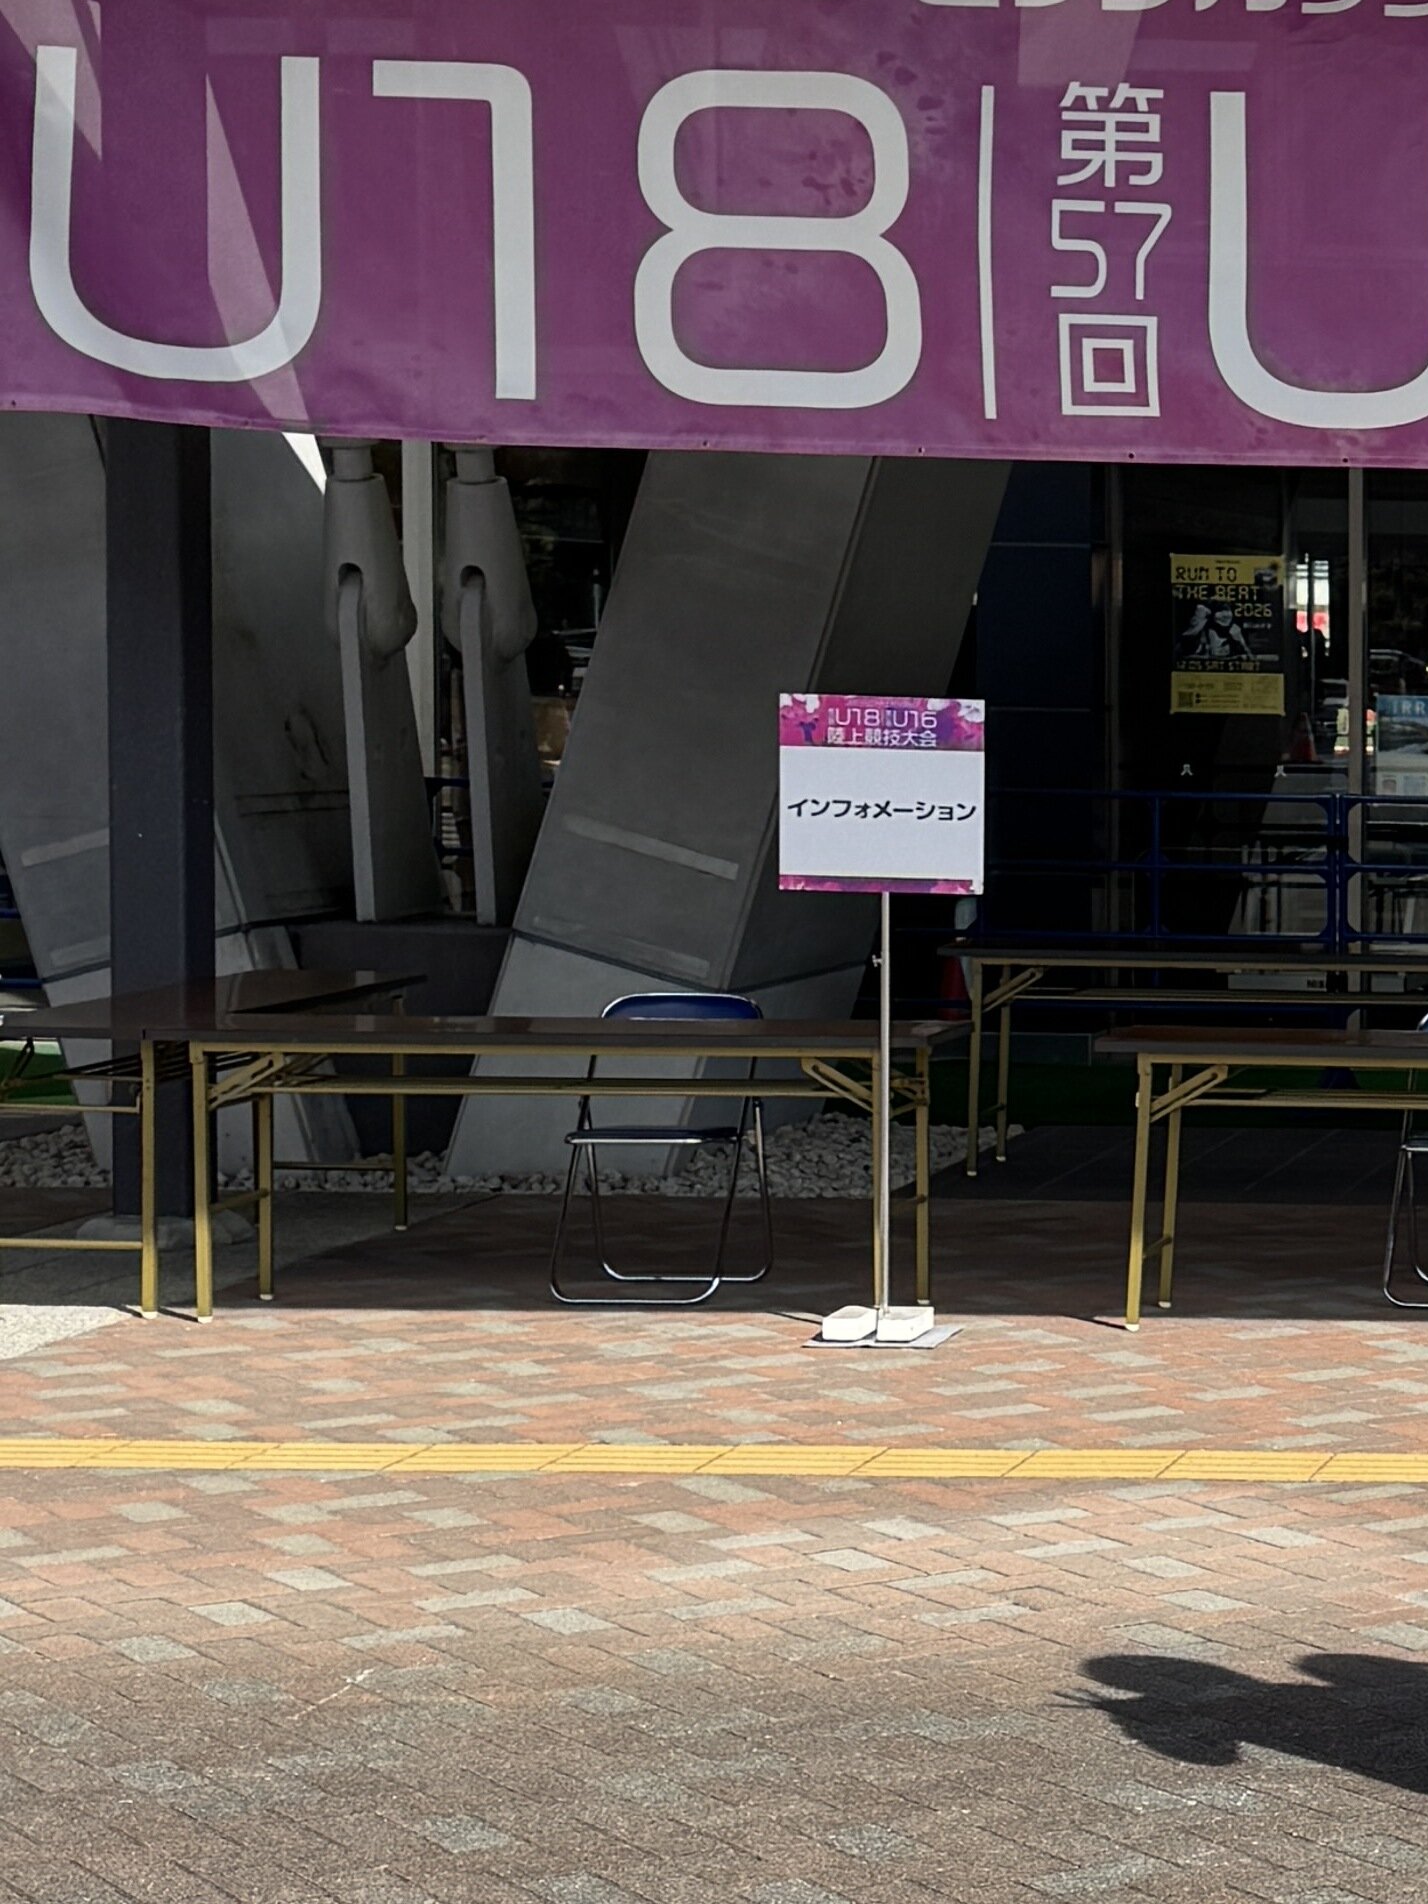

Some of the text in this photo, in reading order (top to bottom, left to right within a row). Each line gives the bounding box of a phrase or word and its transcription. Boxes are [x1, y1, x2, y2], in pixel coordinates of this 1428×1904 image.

[29, 45, 923, 409] U18
[1175, 566, 1237, 582] RUN TO
[1234, 602, 1273, 618] 2026
[828, 727, 937, 747] 陸上競技大会
[788, 798, 976, 821] インフォメーション
